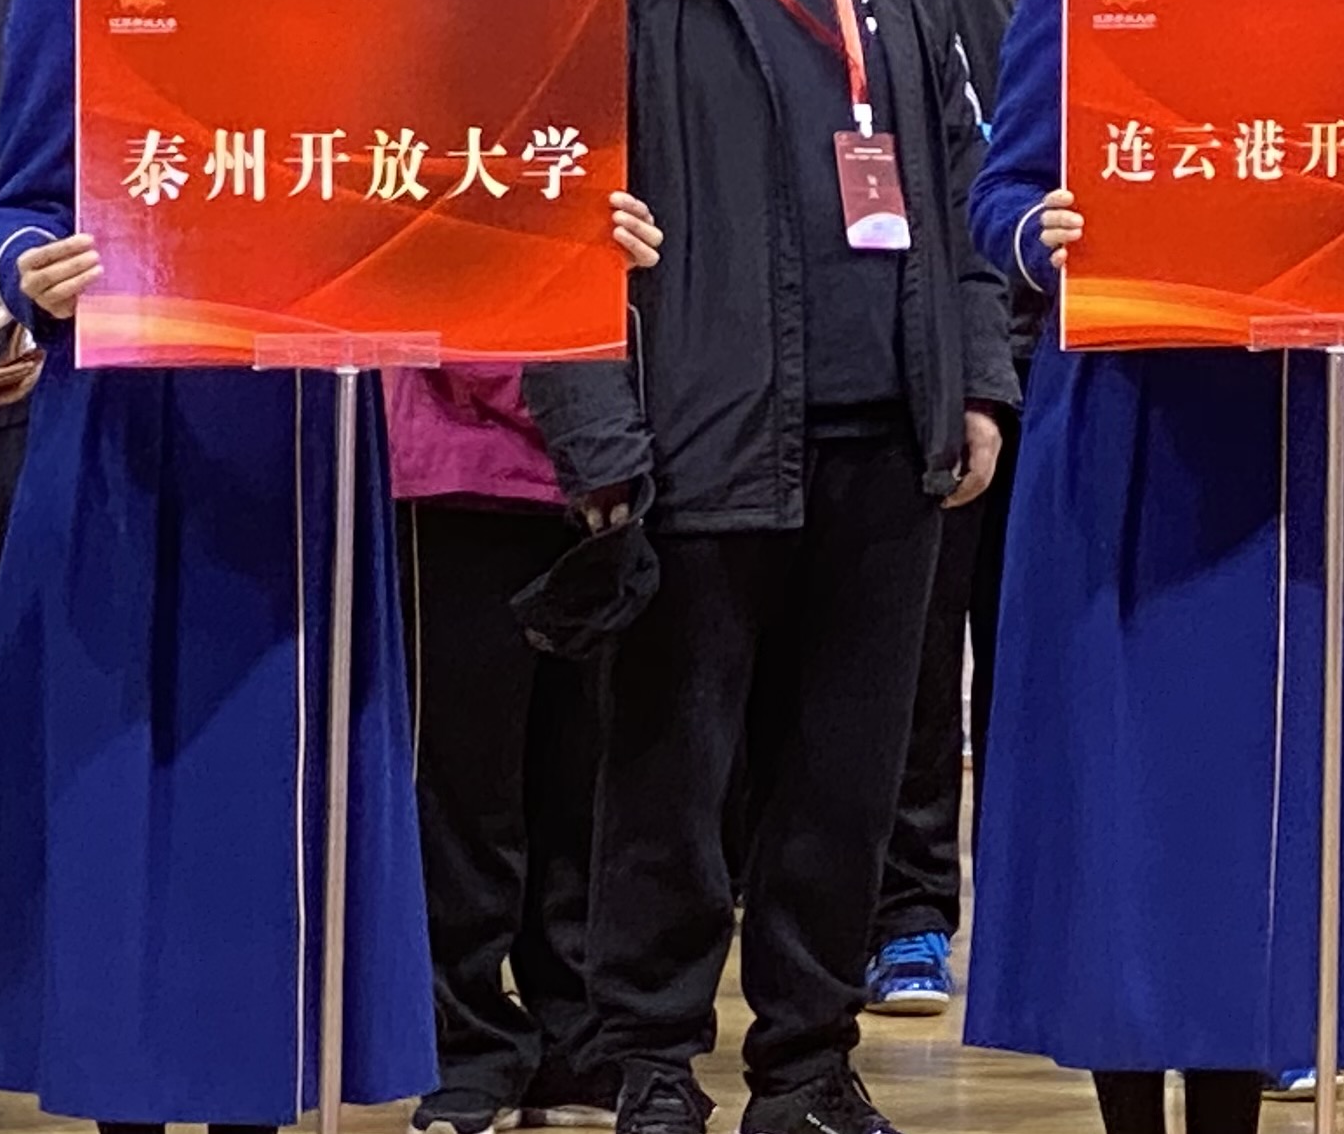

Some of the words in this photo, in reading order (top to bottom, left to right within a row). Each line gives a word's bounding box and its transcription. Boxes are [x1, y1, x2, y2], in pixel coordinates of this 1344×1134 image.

[120, 124, 589, 206] 泰州开放大学
